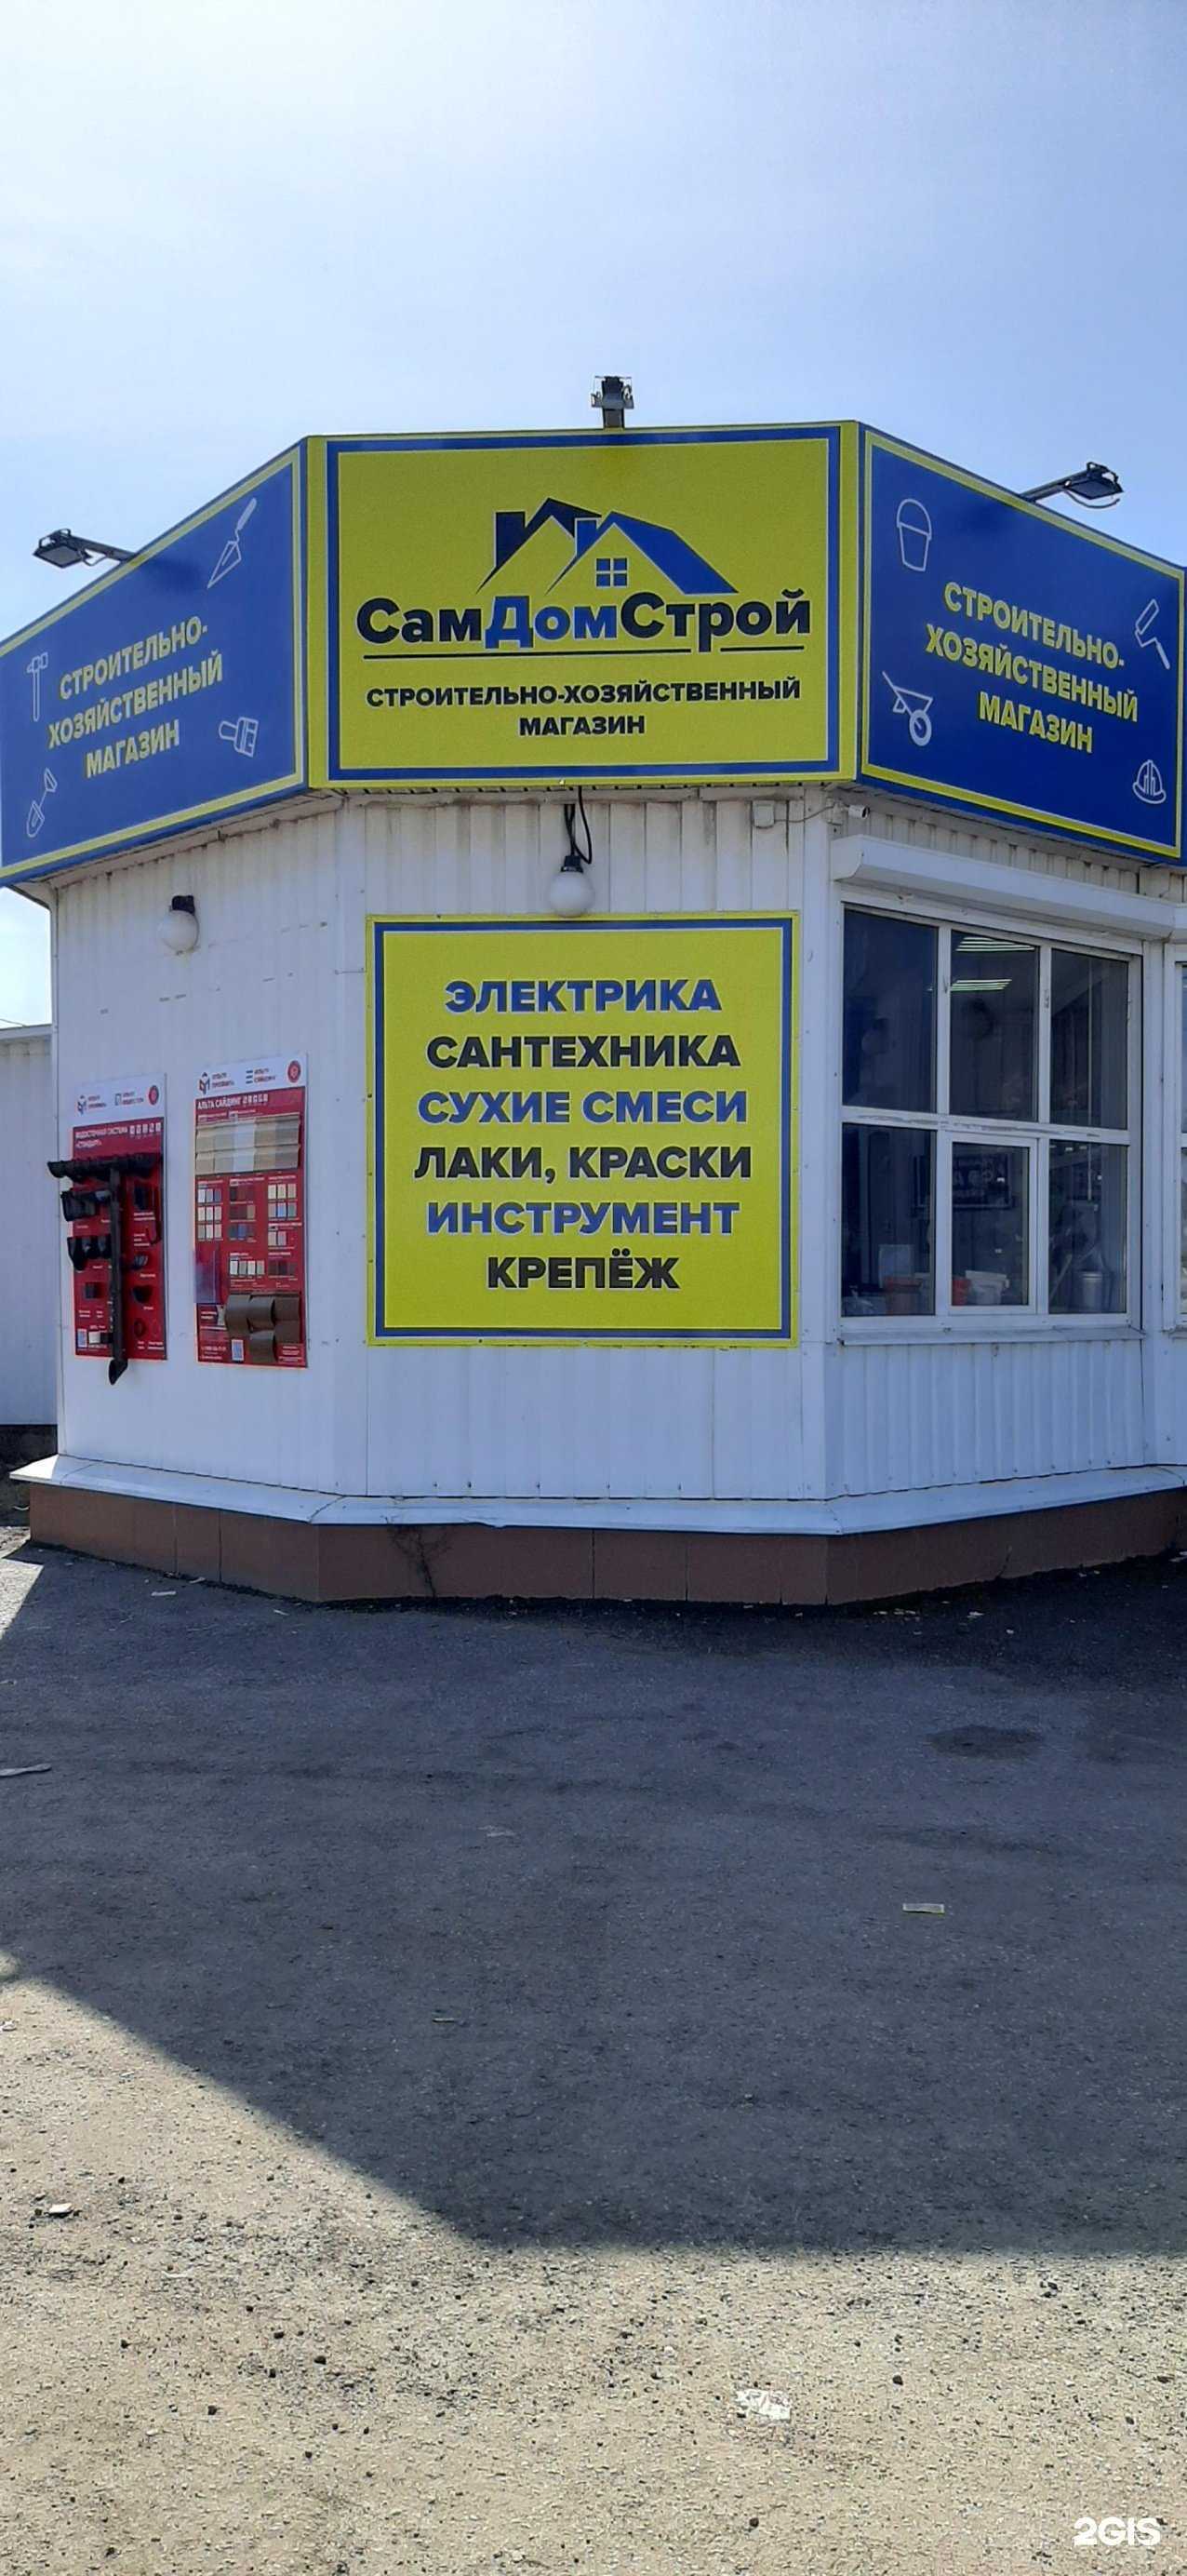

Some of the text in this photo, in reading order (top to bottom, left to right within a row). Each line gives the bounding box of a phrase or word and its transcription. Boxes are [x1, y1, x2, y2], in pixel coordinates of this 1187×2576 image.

[356, 588, 811, 652] СамДомСтрой
[943, 581, 1126, 668] СТРОИТЕЛЬНО-
[60, 616, 207, 700] СТРОИТЕЛЬНО-
[926, 624, 1139, 722] ХОЗЯЙСТВЕННЫЙ
[48, 649, 223, 749] ХОЗЯЙСТВЕННЫЙ
[367, 676, 801, 708] СТРОИТЕЛЬНО-ХОЗЯЙСТВЕННЫЙ
[519, 715, 646, 737] МАГАЗИН
[979, 691, 1093, 753] МАГАЗИН
[87, 718, 180, 778] МАГАЗИН
[444, 979, 723, 1013] ЭЛЕКТРИКА
[425, 1035, 741, 1068] САНТЕХНИКА
[417, 1091, 747, 1124] СУХИЕ СМЕСИ
[414, 1147, 753, 1185] ЛАКИ, КРАСКИ
[427, 1202, 740, 1235] ИНСТРУМЕНТ
[487, 1248, 681, 1290] КРЕПЁЖ
